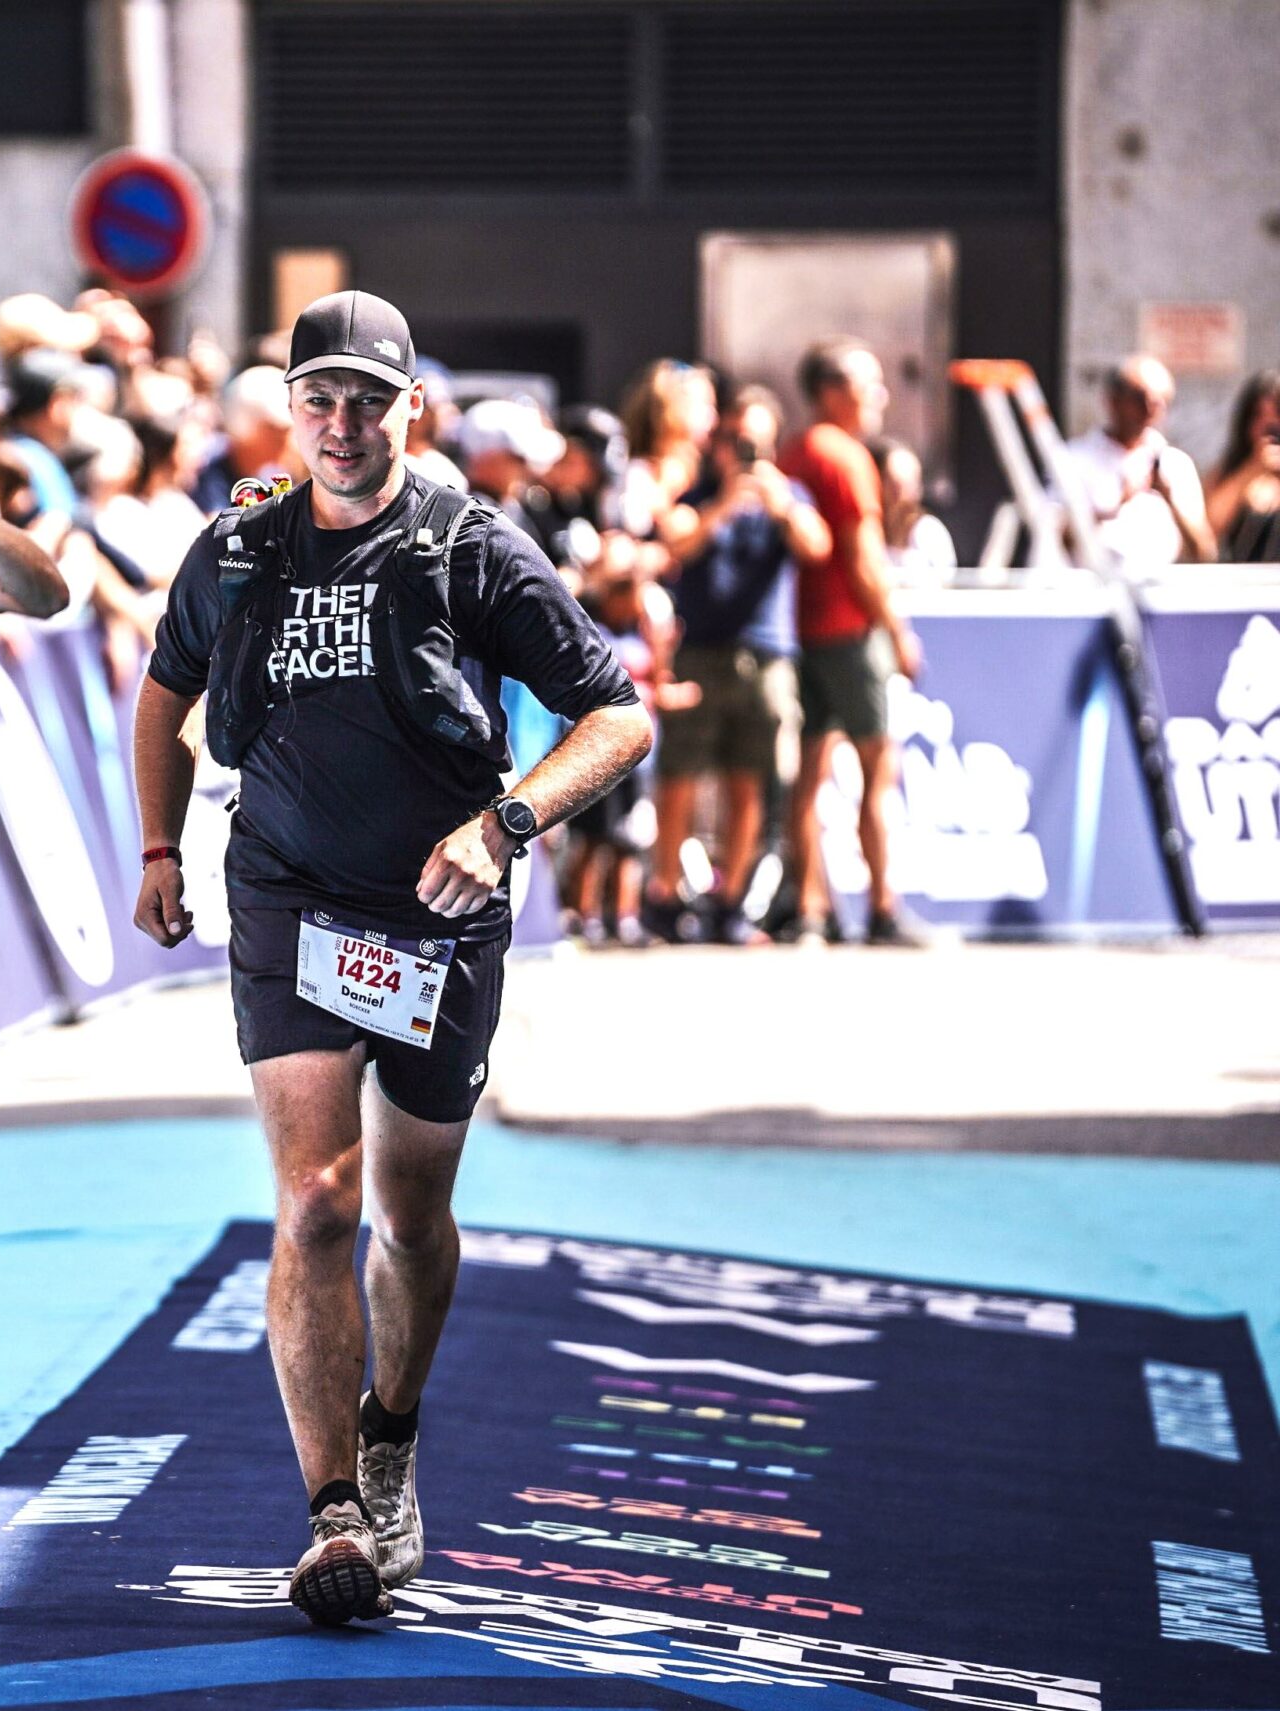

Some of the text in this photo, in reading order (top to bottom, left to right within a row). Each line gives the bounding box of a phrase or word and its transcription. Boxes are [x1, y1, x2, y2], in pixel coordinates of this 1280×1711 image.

[289, 584, 361, 617] THE
[283, 616, 362, 650] RTH
[266, 646, 361, 683] FACE
[336, 954, 402, 994] 1424
[341, 985, 385, 1009] Daniel
[170, 1565, 1098, 1694] MONT-BLAC
